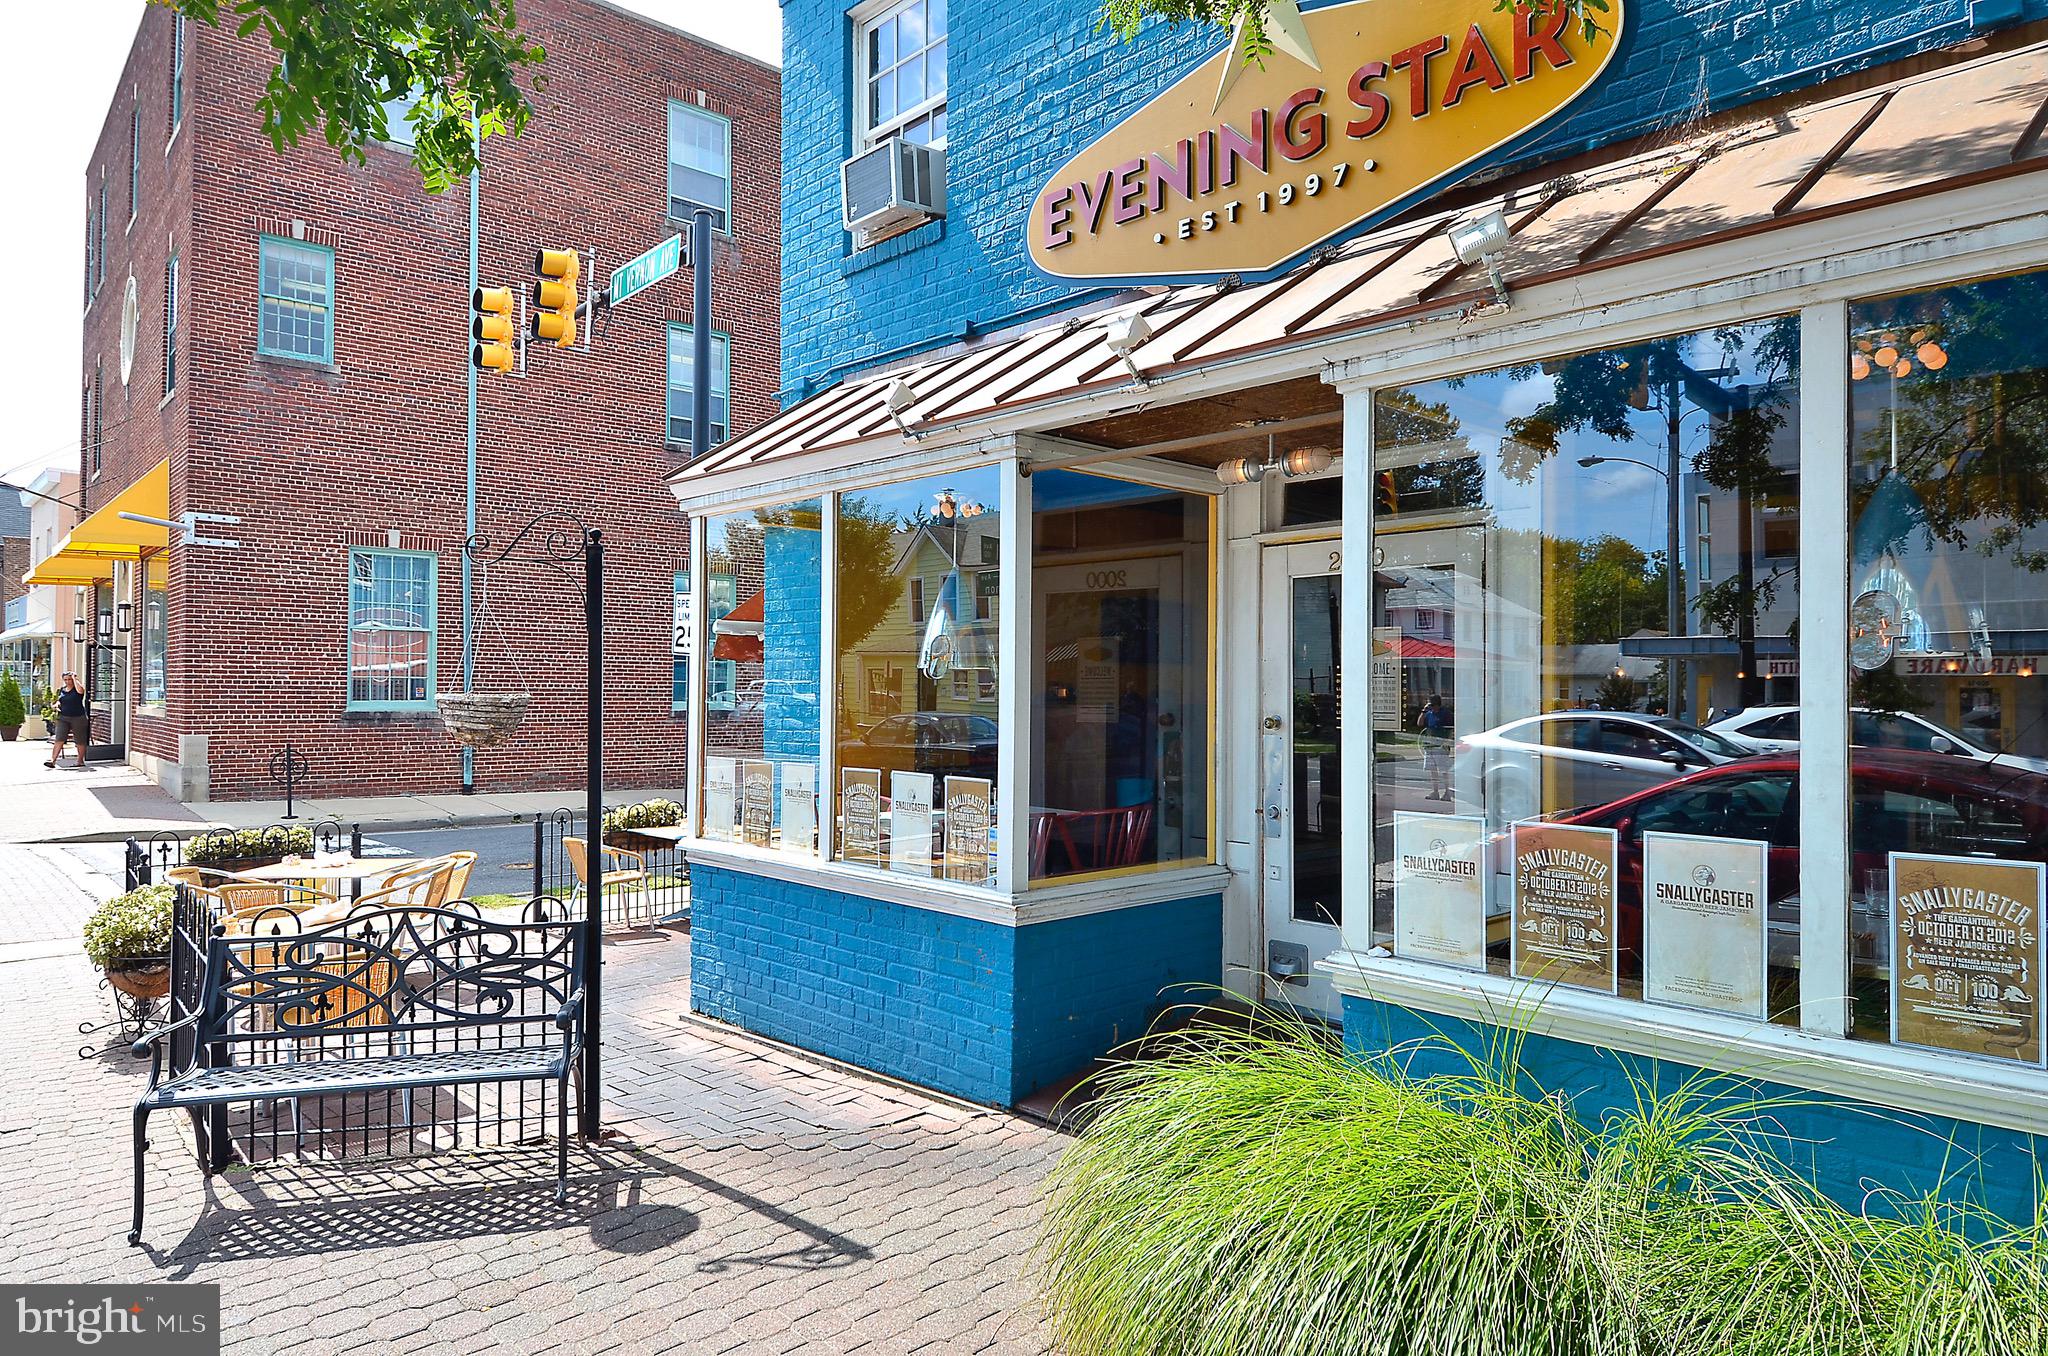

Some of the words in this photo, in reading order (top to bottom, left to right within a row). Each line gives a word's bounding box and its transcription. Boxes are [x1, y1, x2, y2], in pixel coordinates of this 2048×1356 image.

[1044, 86, 1327, 251] EVENING
[1346, 0, 1576, 141] STAR
[1179, 201, 1241, 240] EST
[1257, 162, 1352, 213] 1997
[614, 271, 623, 300] MT
[627, 253, 656, 293] VERNON
[661, 243, 676, 273] AVE
[677, 599, 690, 609] SPE
[678, 612, 690, 621] LIM
[675, 626, 691, 648] 2
[1403, 855, 1476, 876] SNALLYGASTER
[1517, 848, 1609, 880] SNALLYGASTER
[1530, 876, 1566, 892] OCTOBER
[1566, 880, 1576, 893] 13
[1577, 881, 1597, 896] 2012
[1656, 882, 1754, 909] SNALLYGASTER
[1899, 887, 2033, 926] SNALLYGASTER
[1541, 921, 1559, 936] OCT
[1567, 926, 1585, 940] 100
[1933, 913, 1947, 923] THE
[1948, 915, 1997, 928] GARGANTUAN
[1918, 921, 1970, 941] OCTOBER
[1971, 926, 1984, 941] 13
[1986, 927, 2016, 945] 2012
[1933, 937, 1953, 947] BEER
[1954, 940, 1997, 952] JAMBOREE
[1934, 977, 1961, 994] OCT
[1971, 982, 1998, 999] 100
